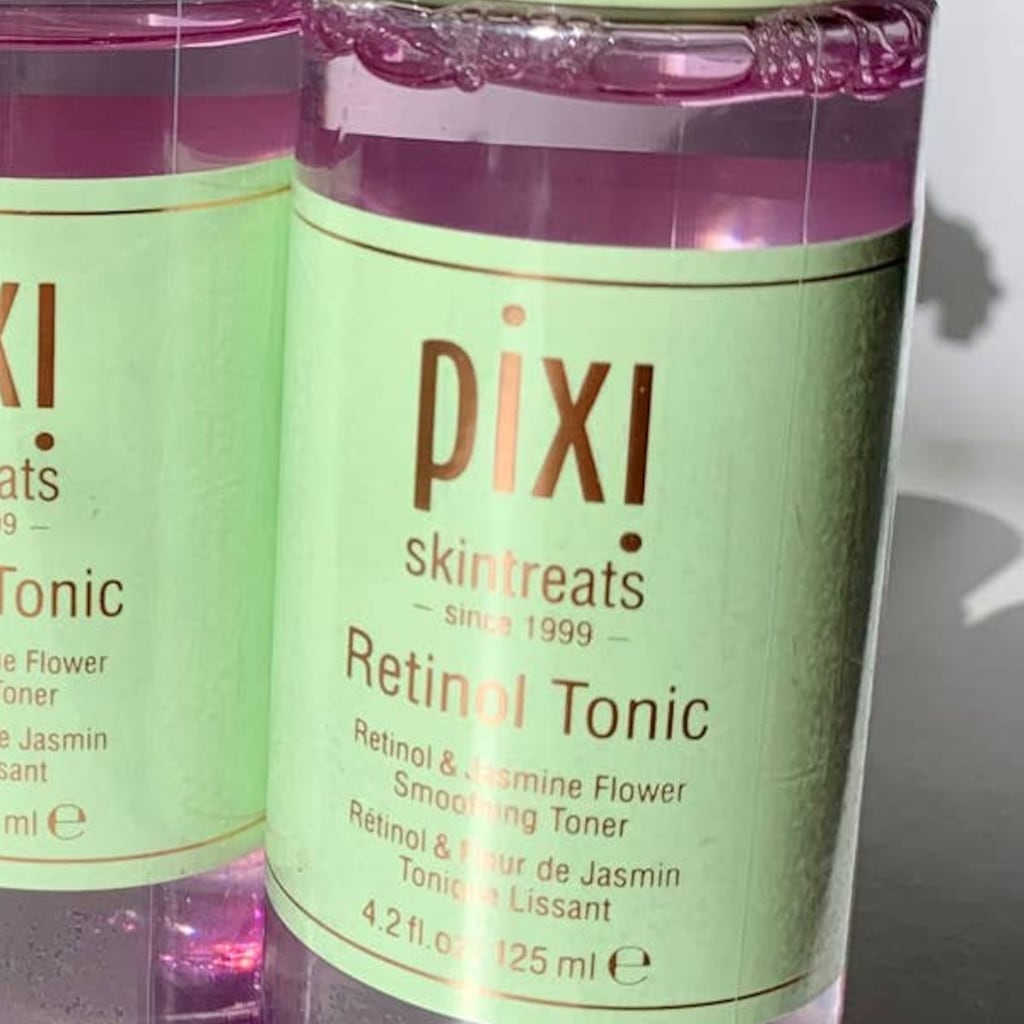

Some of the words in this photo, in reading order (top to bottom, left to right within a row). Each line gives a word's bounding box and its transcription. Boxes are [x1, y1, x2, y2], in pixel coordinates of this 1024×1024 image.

[406, 531, 645, 610] skintreats
[445, 604, 513, 636] since
[527, 615, 593, 646] 1999
[26, 650, 108, 674] Flower
[346, 625, 526, 728] Retinol
[552, 678, 710, 742] Tonic
[19, 728, 107, 751] Jasmin
[354, 718, 432, 769] Retinol
[440, 750, 456, 776] &
[594, 774, 687, 803] Flower
[5, 810, 37, 836] ml
[551, 805, 628, 838] Toner
[349, 799, 426, 852] Rétinol
[434, 833, 451, 860] &
[537, 856, 570, 883] de
[580, 860, 680, 888] Jasmin
[510, 884, 611, 922] Lissant
[362, 899, 401, 938] 4.2
[497, 939, 548, 975] 125
[557, 952, 596, 981] ml
